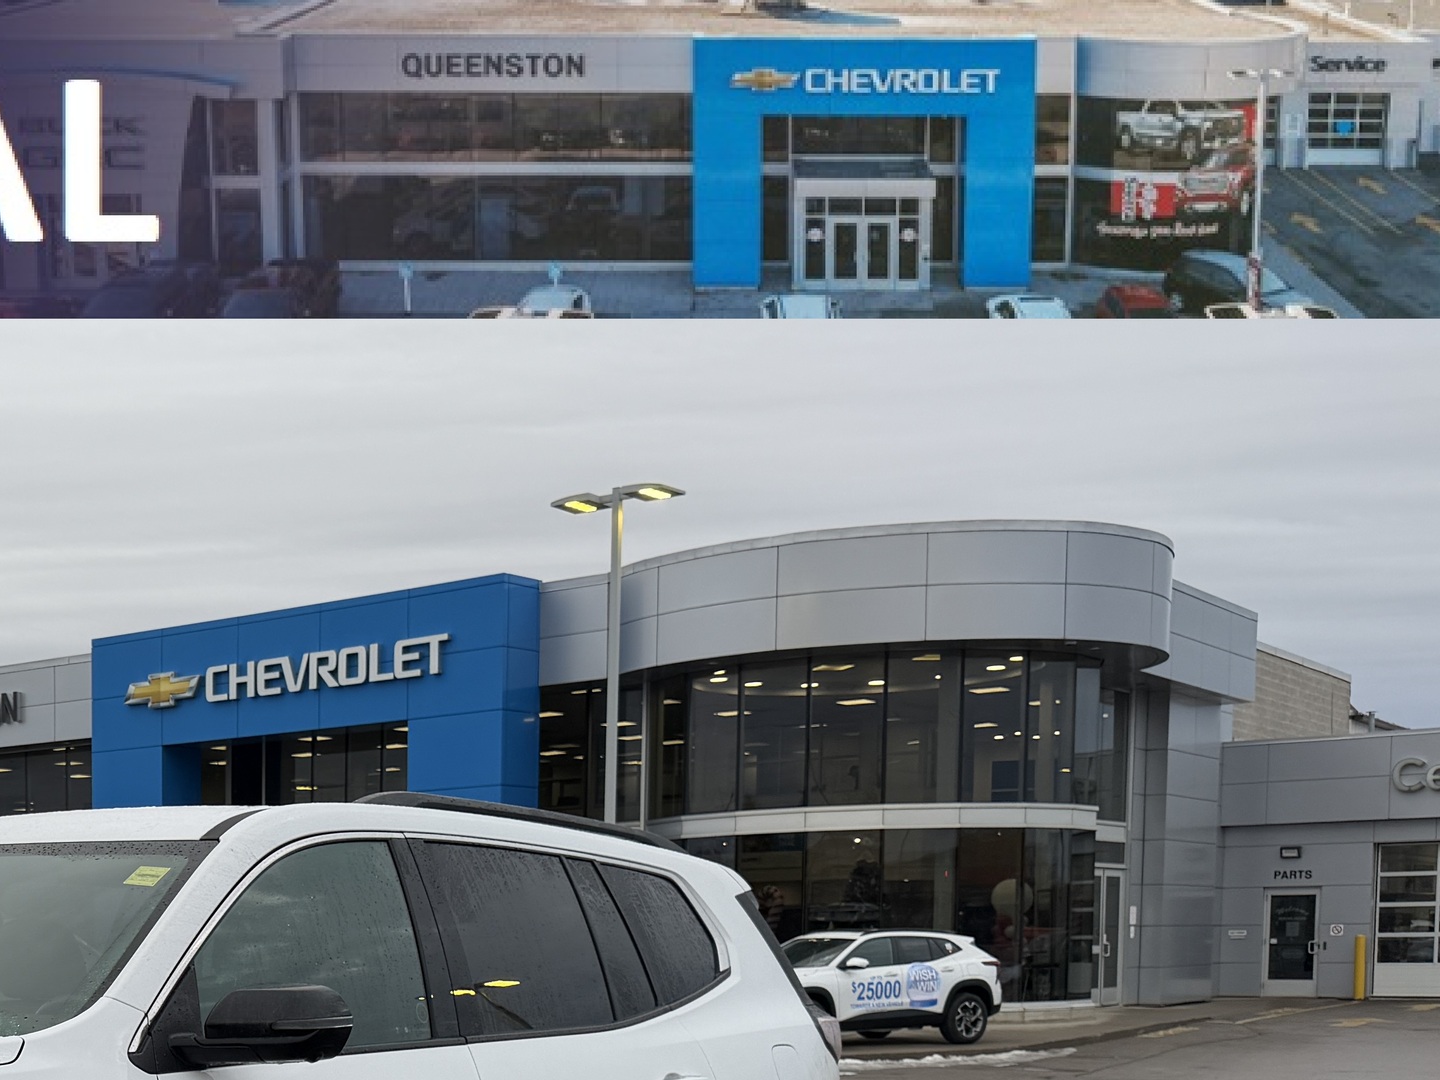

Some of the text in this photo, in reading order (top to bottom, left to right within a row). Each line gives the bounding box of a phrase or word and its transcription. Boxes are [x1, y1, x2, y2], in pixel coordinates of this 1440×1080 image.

[204, 632, 450, 702] CHEVROLET
[1273, 870, 1313, 880] PARTS
[910, 969, 937, 981] WISH
